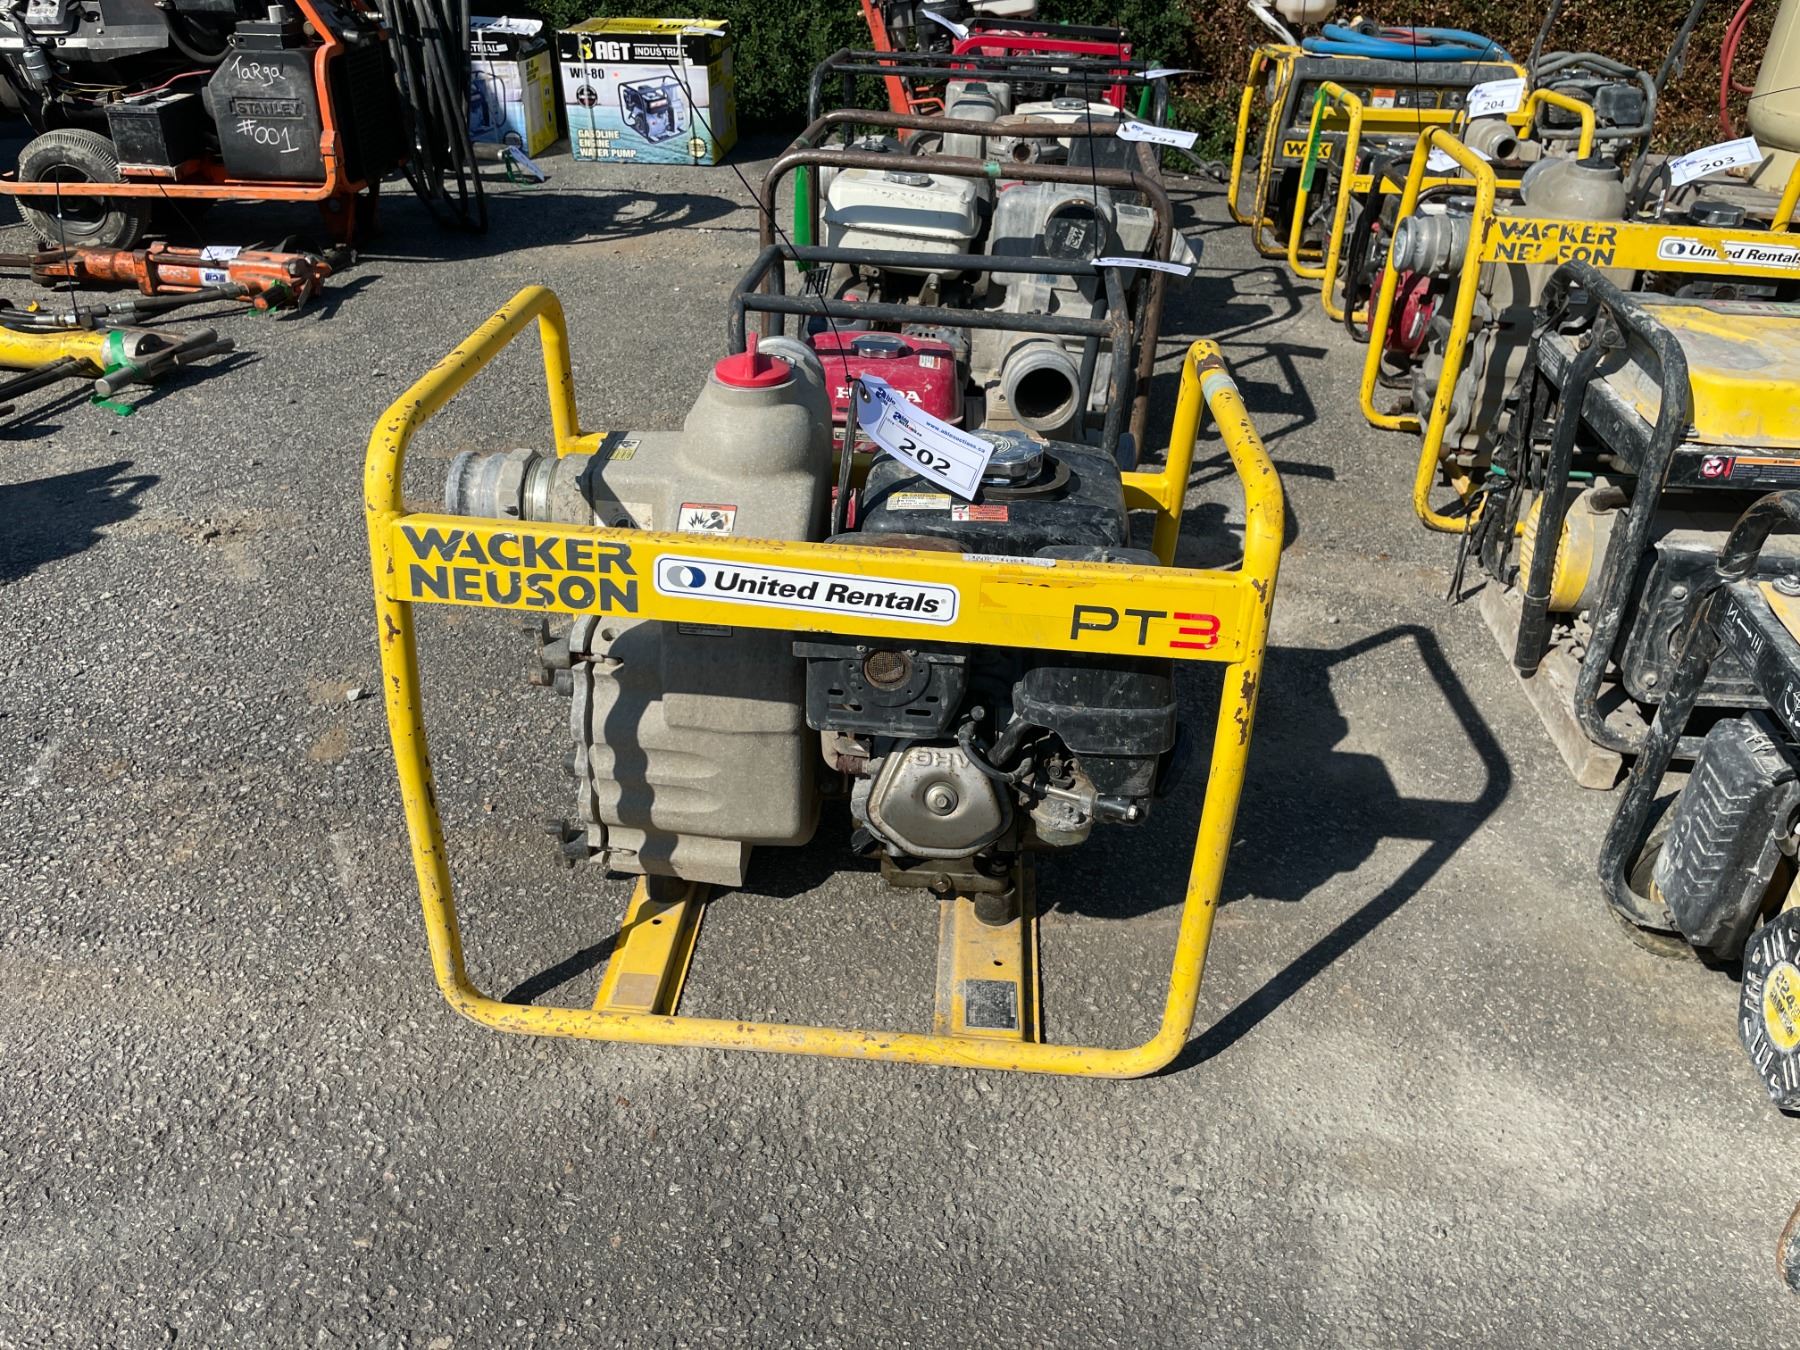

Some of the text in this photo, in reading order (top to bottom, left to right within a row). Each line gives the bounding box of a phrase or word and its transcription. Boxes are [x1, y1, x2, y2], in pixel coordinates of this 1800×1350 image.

[594, 41, 688, 60] AGT INDUSTRIAL
[236, 101, 300, 116] STANLEY
[1483, 99, 1505, 111] 204
[236, 119, 300, 154] #001
[578, 129, 621, 139] GASOLINE
[579, 138, 611, 148] ENGINE
[579, 147, 637, 158] WATER PUMP
[1700, 156, 1736, 172] 203
[1500, 221, 1618, 246] WACKER
[1689, 244, 1745, 260] Unied
[926, 421, 986, 454] www.ableauctions.ca
[898, 437, 952, 476] 202
[400, 525, 638, 575] WACKER
[409, 563, 639, 613] NEUSON
[713, 570, 940, 613] United Rentals
[1070, 604, 1221, 650] PT3
